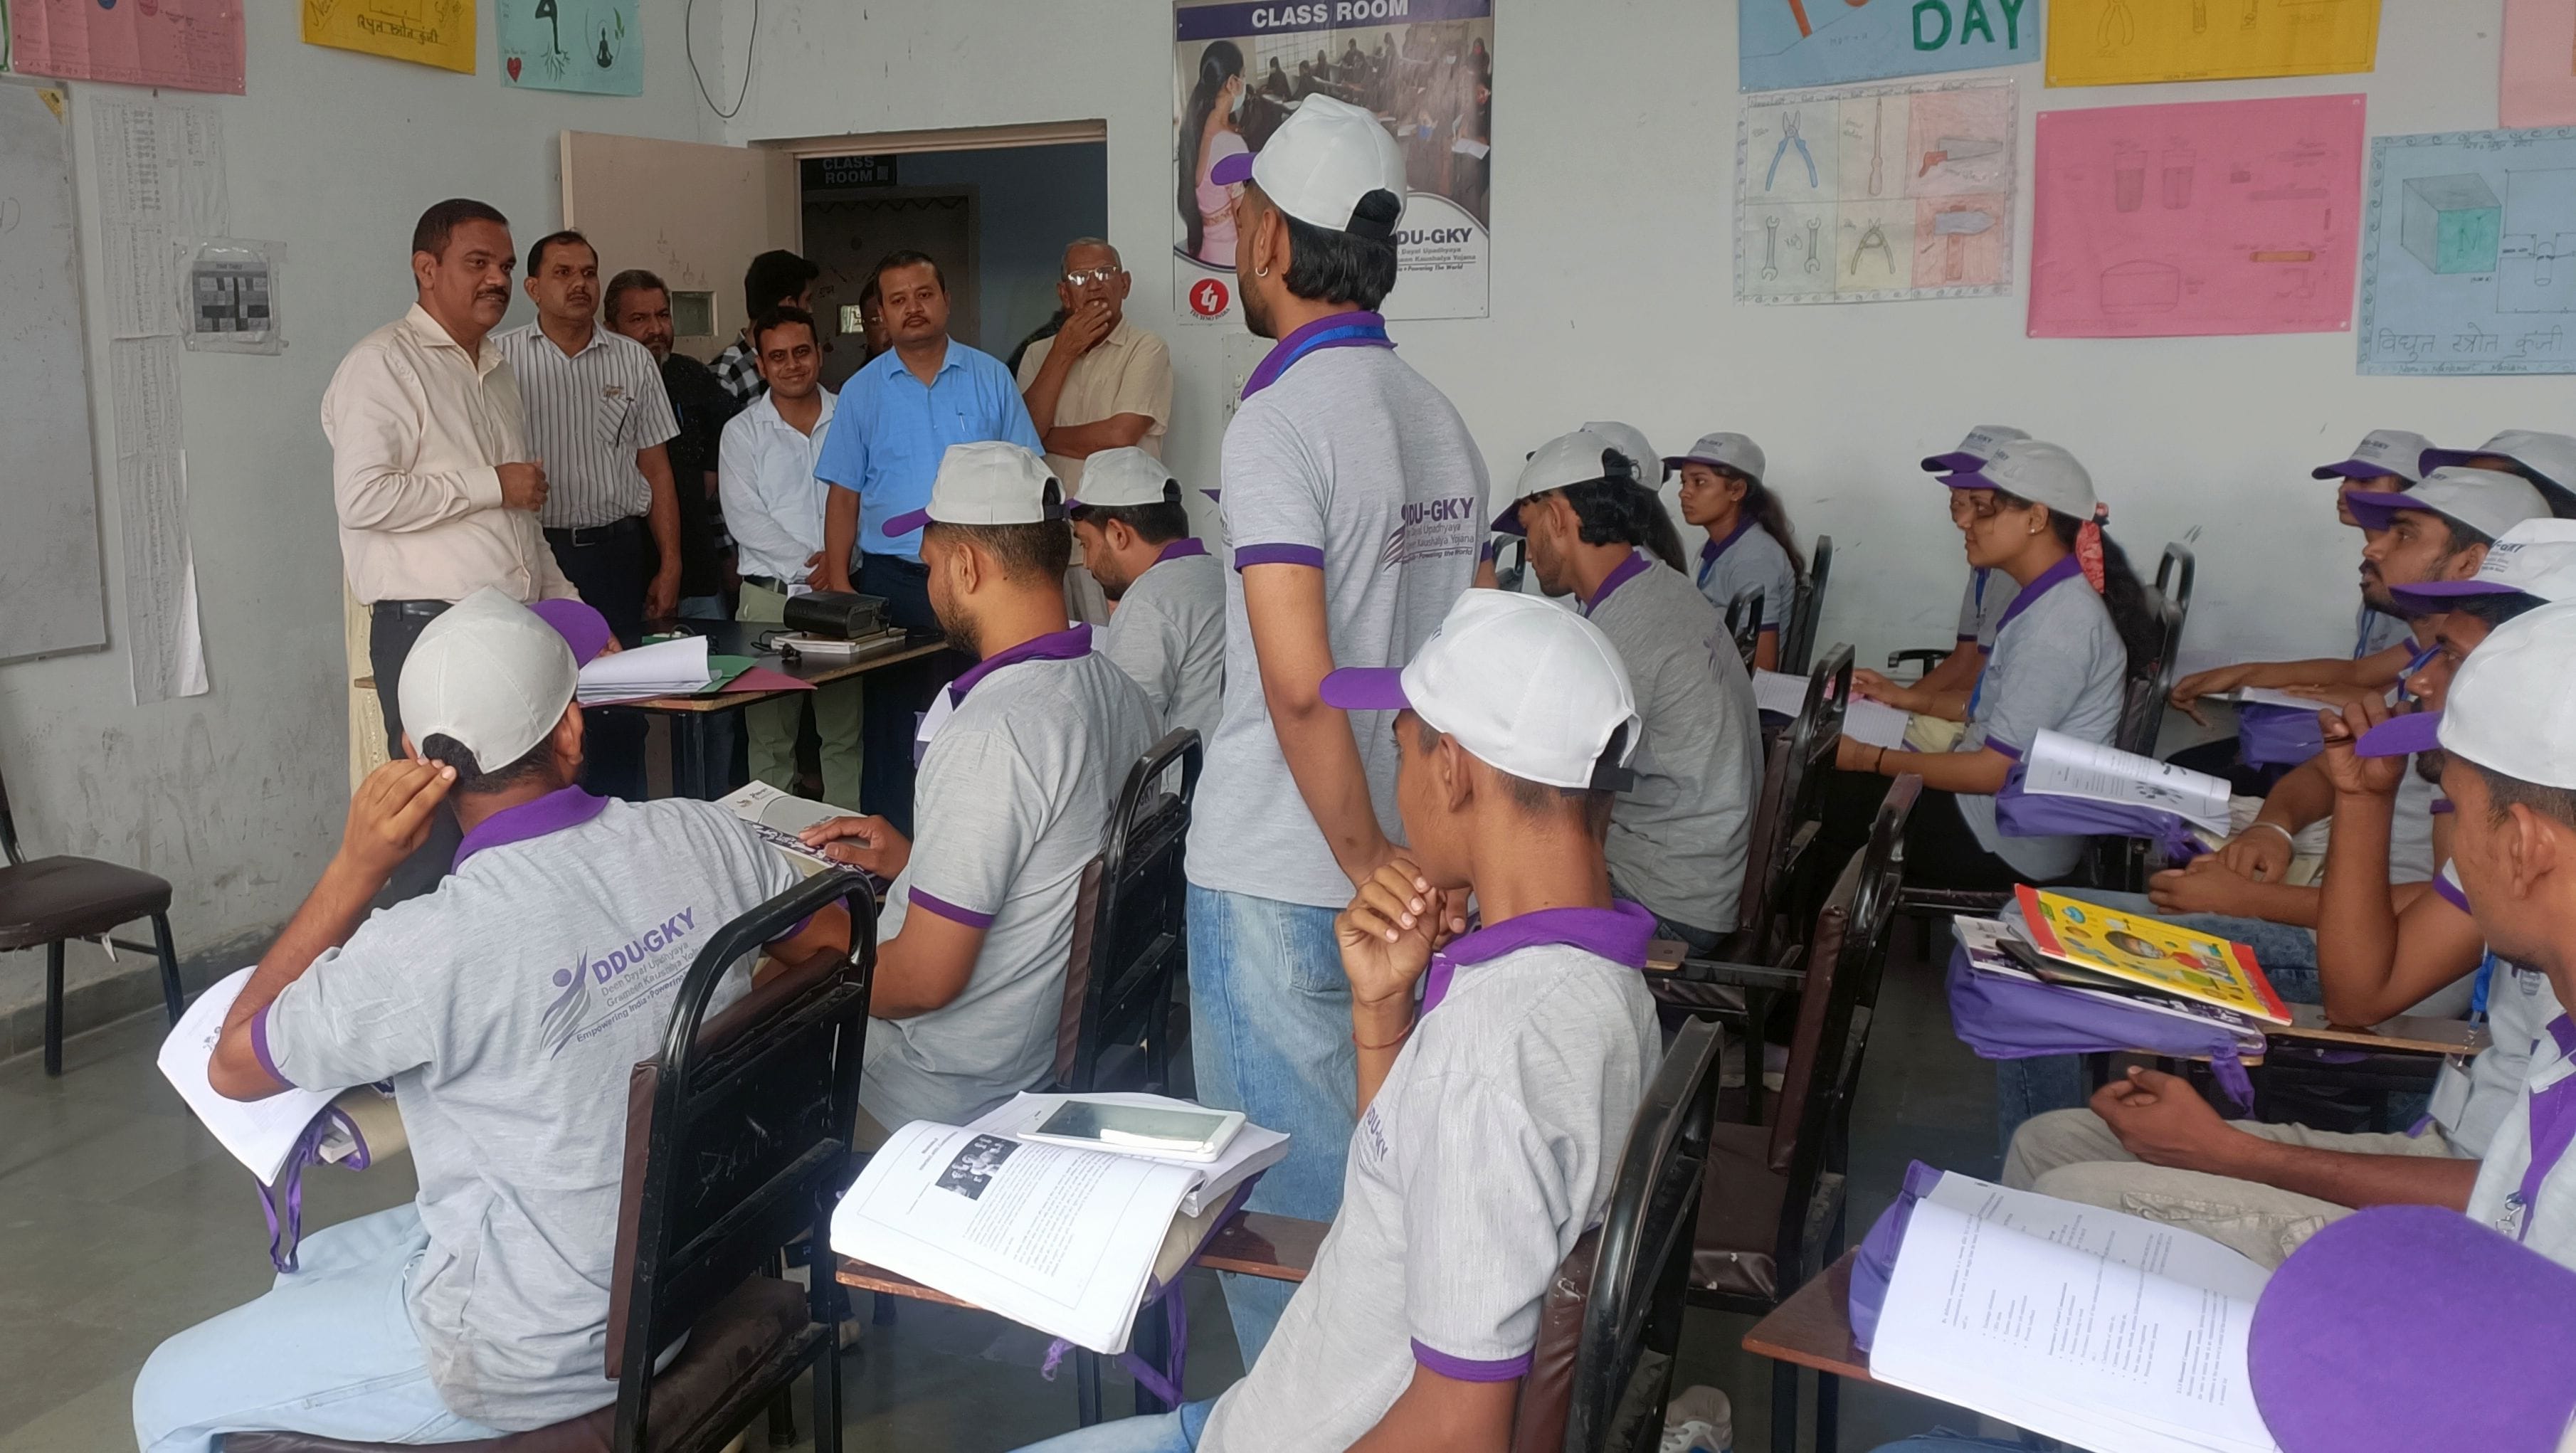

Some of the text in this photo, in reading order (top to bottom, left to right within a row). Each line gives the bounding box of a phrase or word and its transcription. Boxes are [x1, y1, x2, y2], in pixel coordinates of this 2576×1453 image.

[1252, 0, 1408, 28] CLASS ROOM
[1912, 0, 2025, 51] DAY
[823, 157, 875, 170] CLASS
[825, 169, 873, 184] ROOM
[1397, 228, 1472, 245] DU-GKY
[1451, 534, 1474, 546] Yojana
[591, 906, 695, 985] DDU-GKY
[601, 979, 624, 996] Deen
[624, 964, 648, 983] Dayal
[576, 975, 685, 1042] Empowering India Powerin
